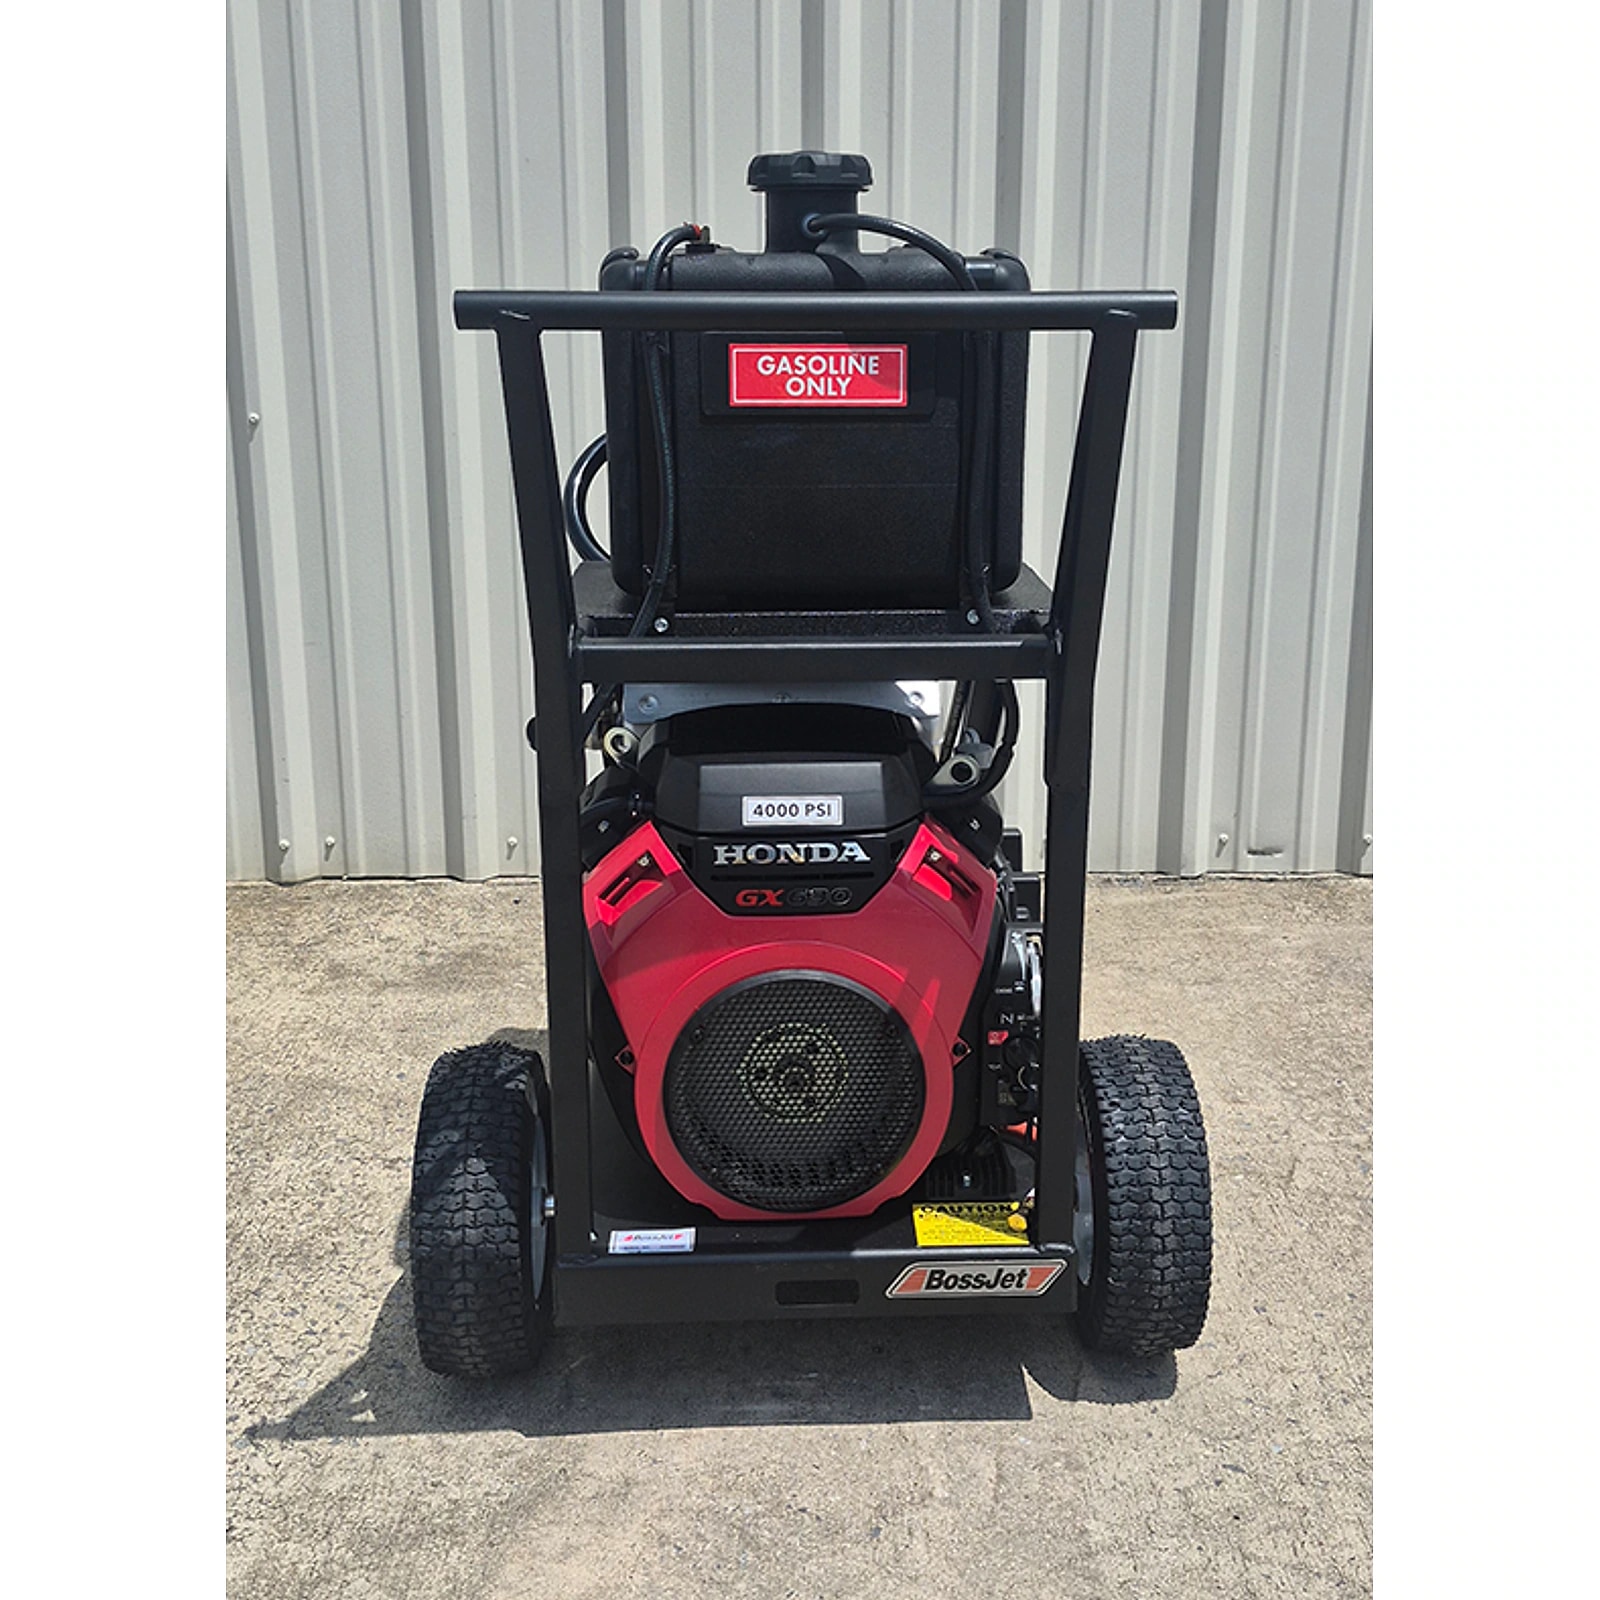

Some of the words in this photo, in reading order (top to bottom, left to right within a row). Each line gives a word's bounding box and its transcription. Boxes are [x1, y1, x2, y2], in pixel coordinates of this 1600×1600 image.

[757, 354, 880, 375] GASOLINE
[785, 377, 851, 396] ONLY
[753, 804, 799, 817] 4000
[804, 803, 832, 816] PSI
[713, 842, 871, 864] HONDA
[920, 1204, 1013, 1213] CAUTION
[925, 1268, 1028, 1290] BossJet
